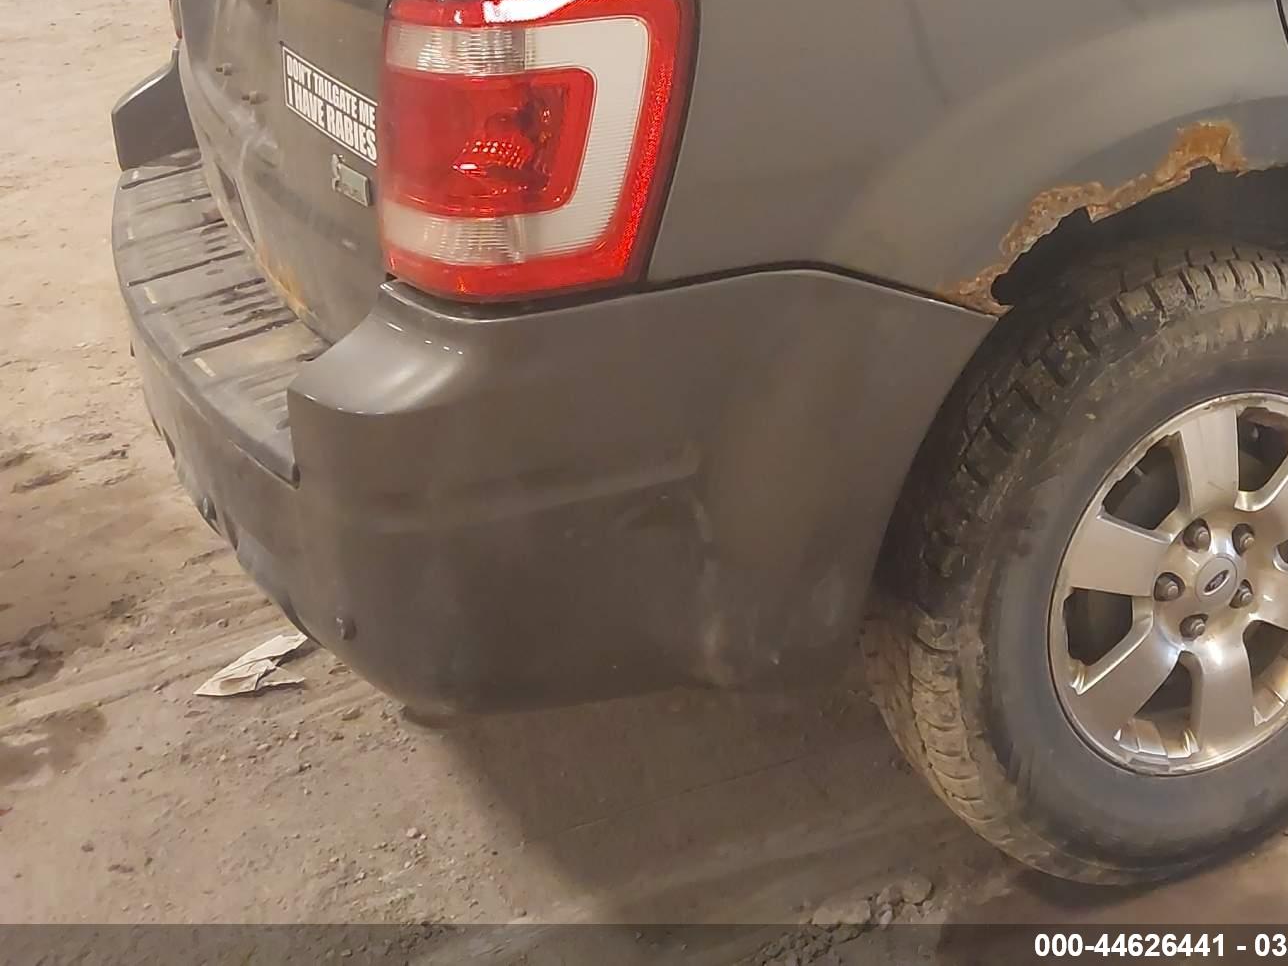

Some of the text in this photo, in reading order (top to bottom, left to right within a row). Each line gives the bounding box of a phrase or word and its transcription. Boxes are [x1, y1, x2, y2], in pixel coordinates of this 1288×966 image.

[286, 54, 376, 130] DON'T TAILGATE ME
[287, 78, 377, 161] I HAVE RABIES
